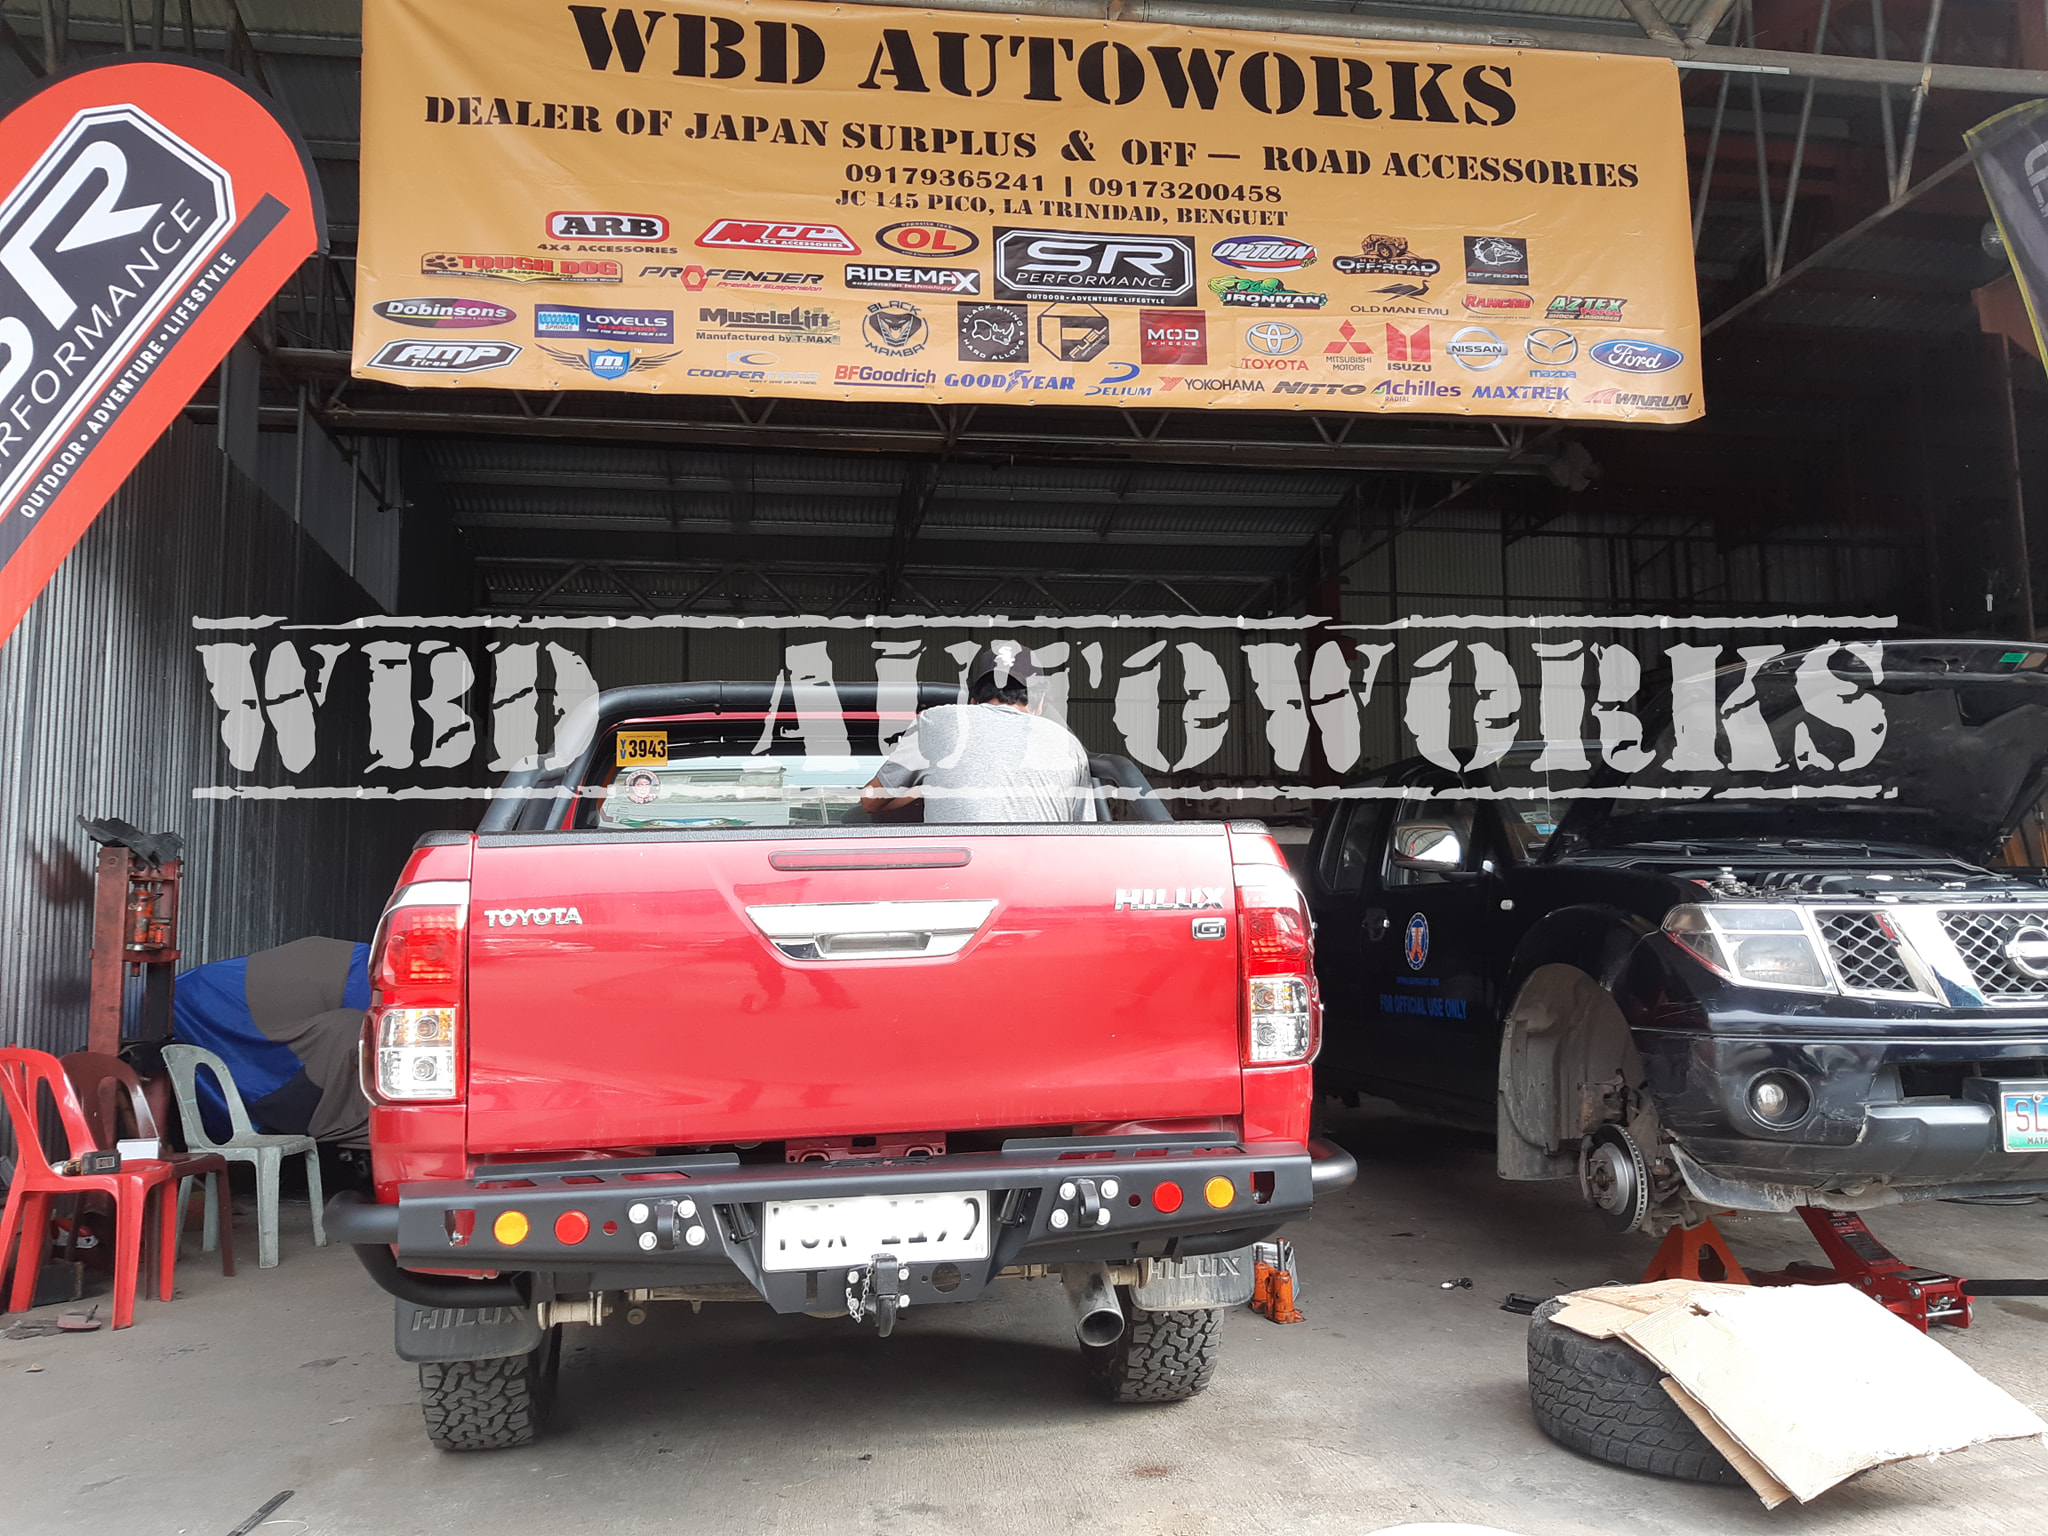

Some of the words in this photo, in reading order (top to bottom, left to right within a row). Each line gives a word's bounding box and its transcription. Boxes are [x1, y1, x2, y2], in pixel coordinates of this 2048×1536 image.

[567, 5, 826, 85] WBD
[857, 28, 1517, 127] AUTOWORKS
[425, 96, 602, 133] DEALER
[614, 108, 673, 137] OF
[684, 112, 829, 148] JAPAN
[841, 121, 1037, 160] SURPLUS
[1061, 130, 1096, 163] &
[1120, 138, 1197, 168] OFF
[1262, 146, 1371, 177] ROAD
[1381, 152, 1640, 189] ACCESSORIES
[844, 163, 1045, 192] 09179365241
[1088, 178, 1282, 203] 09173200458
[834, 190, 867, 208] JC
[872, 191, 919, 211] 145
[928, 195, 994, 217] PICO,
[1003, 199, 1032, 215] LA
[1039, 200, 1168, 225] TRINIDAD,
[1176, 207, 1289, 228] BENGUET
[559, 216, 658, 238] ARB
[781, 240, 844, 248] ACCESSORIES
[897, 228, 957, 251] OL
[537, 243, 571, 252] 4X4
[577, 245, 679, 255] ACCESSORIES
[1212, 243, 1314, 261] OPTION
[458, 255, 554, 273] TOUGH
[561, 260, 617, 276] DOG
[1016, 240, 1175, 277] SR
[1336, 259, 1438, 273] OFF-ROAD
[716, 281, 761, 289] Premium
[763, 282, 822, 292] Suspension
[846, 266, 980, 294] RIDEMAX
[904, 283, 953, 292] technology
[1015, 272, 1173, 288] PERFORMANCE
[1026, 293, 1065, 301] OUTDOOR
[1071, 295, 1118, 303] ADVENTURE
[1124, 297, 1165, 305] LIFESTYLE
[1226, 293, 1320, 305] IRONMAN
[1465, 294, 1532, 309] RANCHO
[1550, 296, 1624, 312] AZTEX
[386, 301, 507, 318] Dobinsons
[867, 300, 922, 316] BLACK
[963, 304, 991, 324] BLACK
[996, 306, 1024, 327] RHINO
[1350, 305, 1381, 313] OLD
[1382, 306, 1416, 314] MAN
[1418, 307, 1449, 316] EMU
[586, 314, 668, 327] LOVELLS
[696, 332, 775, 342] Manufactured
[778, 334, 792, 344] by
[1147, 328, 1200, 341] MOD
[393, 345, 501, 366] AMP
[865, 342, 925, 358] MAMBA
[963, 338, 987, 359] HARD
[991, 339, 1025, 361] ALLOYS
[1451, 345, 1502, 353] NISSAN
[1608, 343, 1663, 369] Ford
[1242, 357, 1309, 371] TOYOTA
[1325, 356, 1372, 364] MITSUBISHI
[1332, 363, 1366, 372] MOTORS
[1387, 362, 1432, 372] ISUZU
[834, 365, 937, 384] BFGoodrich
[944, 371, 1076, 391] GOODYEAR
[1529, 369, 1577, 379] mazda
[19, 430, 89, 519] OUTDOOR
[86, 338, 165, 441] ADVENTURE
[166, 250, 238, 336] LIFESTYLE
[1084, 385, 1153, 397] DELIUM
[1184, 378, 1266, 392] YOKOHAMA
[1271, 380, 1367, 395] NITTO
[1370, 379, 1462, 398] Achilles
[1471, 385, 1570, 401] MAXTREK
[1614, 392, 1694, 408] WINRUN
[628, 739, 666, 759] 3943
[1114, 887, 1226, 911] HILUX
[484, 907, 583, 927] TOYOTA
[1428, 997, 1444, 1017] USE
[1445, 998, 1467, 1020] ONLY
[411, 1306, 527, 1332] HILUX
